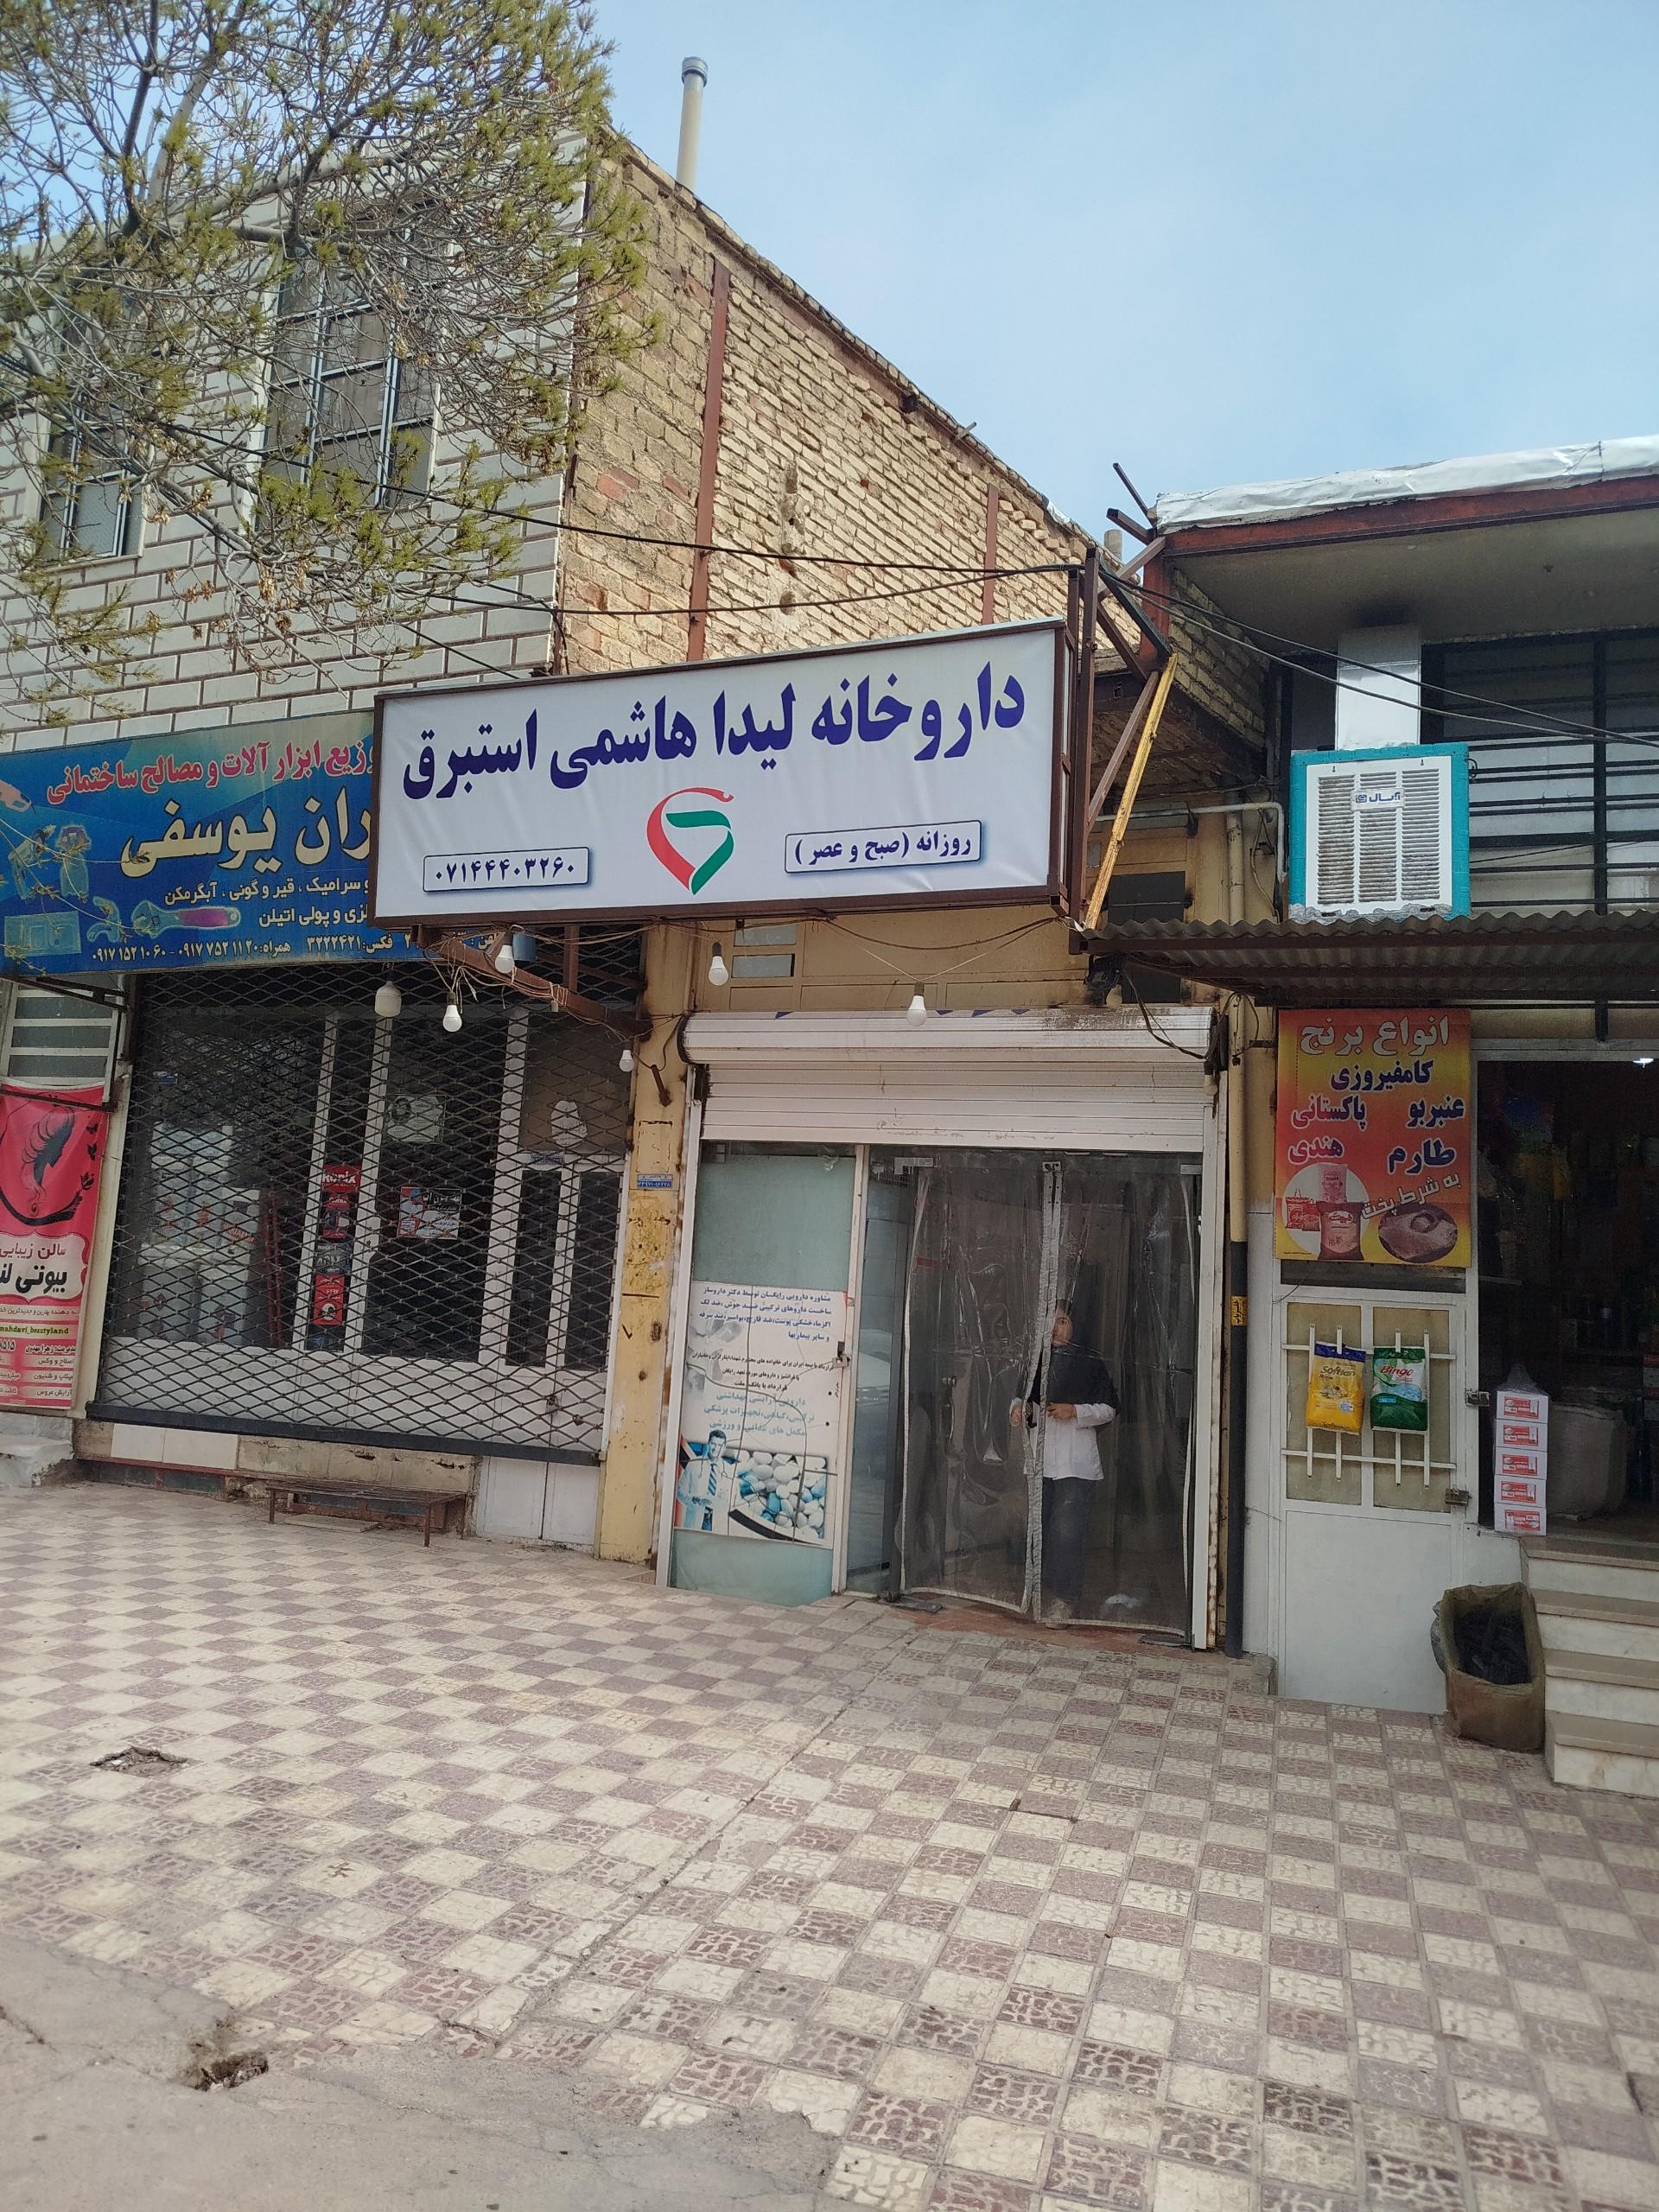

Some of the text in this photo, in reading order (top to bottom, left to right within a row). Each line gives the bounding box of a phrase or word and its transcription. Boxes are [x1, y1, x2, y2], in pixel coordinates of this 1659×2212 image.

[403, 662, 1026, 800] داروخانه لیدا هاشمی استبرق
[221, 741, 270, 777] آلات
[273, 740, 321, 779] ابزار
[47, 760, 139, 805] ساختمانی
[140, 754, 204, 794] مصالح
[206, 760, 219, 789] و
[120, 798, 277, 879] یوسفی
[849, 843, 858, 863] و
[916, 830, 971, 857] روزانه
[435, 856, 575, 883] ۰۷۱۴۴۴۰۳۲۶۰
[164, 881, 217, 906] آبگرمکن
[229, 879, 258, 900] گونی
[262, 884, 270, 899] و
[273, 877, 295, 899] قیر
[306, 876, 360, 895] سرامیک
[259, 907, 295, 927] اتیلن
[298, 906, 330, 928] پولی
[333, 909, 340, 925] و
[1300, 1014, 1449, 1056] انواع برنج
[1331, 1059, 1435, 1091] کامفیروزی
[1292, 1094, 1367, 1131] پاکستانی
[1407, 1095, 1465, 1128] عنبربو
[1287, 1135, 1345, 1164] هندی
[1388, 1139, 1458, 1174] طارم
[1361, 1172, 1460, 1220] به شرط پخت
[0, 1263, 67, 1294] بیوتی لن
[727, 1287, 741, 1296] دکتر
[810, 1293, 831, 1302] مشاوره
[1380, 1366, 1414, 1376] Bingo
